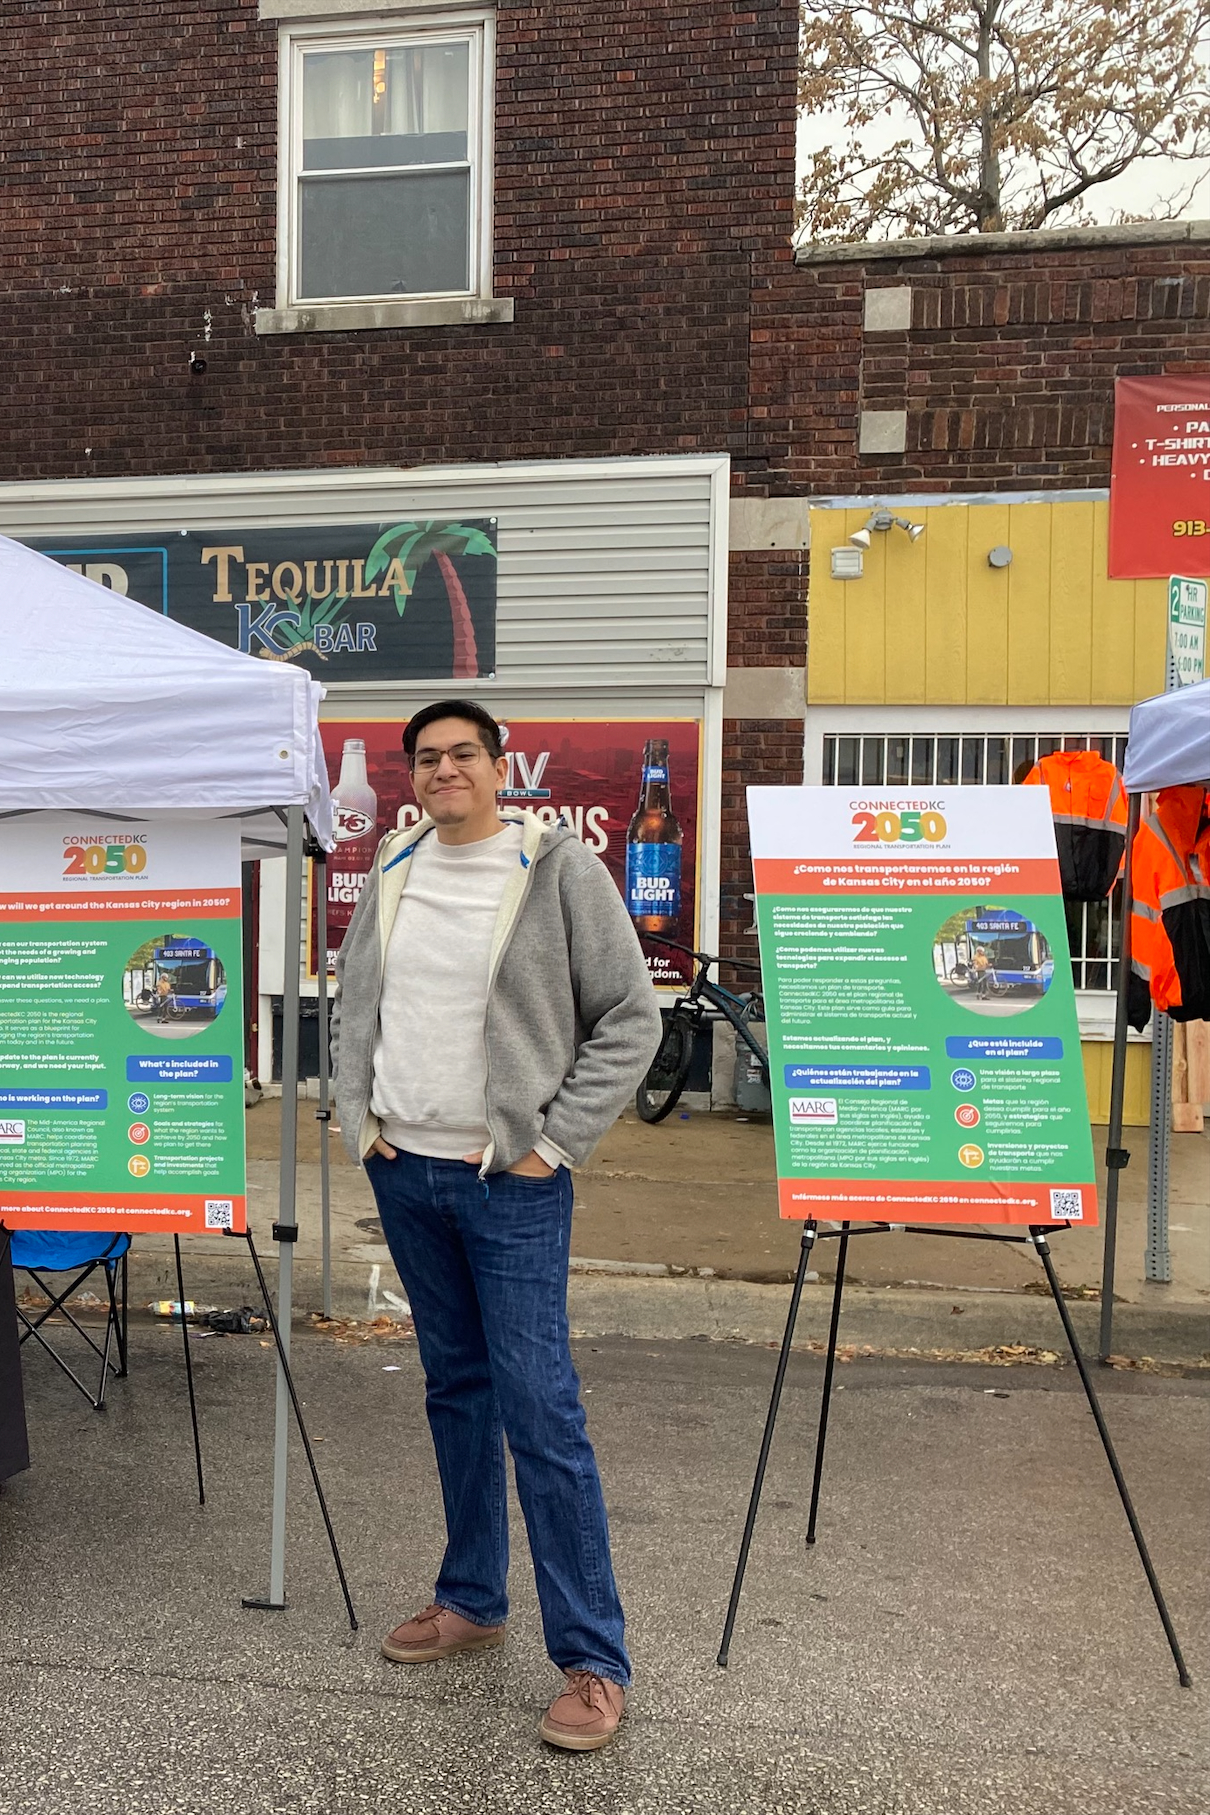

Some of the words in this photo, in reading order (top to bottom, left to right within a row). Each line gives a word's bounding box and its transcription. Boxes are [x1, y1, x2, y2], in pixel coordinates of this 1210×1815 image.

[201, 546, 412, 603] TEQUILA
[1172, 586, 1179, 615] 2
[1187, 587, 1198, 602] HR
[1180, 605, 1204, 622] PARKING
[235, 603, 301, 656] KC
[314, 623, 377, 652] BAR
[1190, 636, 1198, 650] AM
[1194, 658, 1203, 673] PM
[849, 800, 945, 810] CONNECTEDKC
[852, 811, 947, 842] 2050
[63, 834, 147, 845] CONNECTEDKC
[62, 845, 147, 875] 2050
[793, 864, 833, 875] ¿Como
[856, 865, 953, 875] transportaremos
[970, 864, 981, 873] la
[983, 863, 1019, 875] región
[636, 878, 670, 889] BUD
[822, 877, 837, 886] de
[838, 878, 881, 886] Kansas
[882, 877, 906, 889] City
[922, 878, 933, 886] el
[934, 877, 956, 886] año
[957, 877, 991, 887] 2050?
[631, 889, 675, 901] LIGHT
[8, 902, 24, 910] will
[40, 902, 55, 912] get
[56, 901, 90, 909] around
[142, 899, 162, 910] City
[163, 899, 192, 909] region
[193, 898, 202, 907] in
[203, 898, 230, 906] 2050?
[29, 940, 81, 948] transportation
[20, 957, 62, 965] population?
[1005, 1048, 1029, 1058] plan?
[174, 1070, 198, 1080] plan?
[810, 1077, 865, 1085] actualización
[879, 1078, 902, 1088] plan?
[16, 1094, 50, 1104] working
[77, 1095, 99, 1104] plan?
[792, 1101, 834, 1113] MARC
